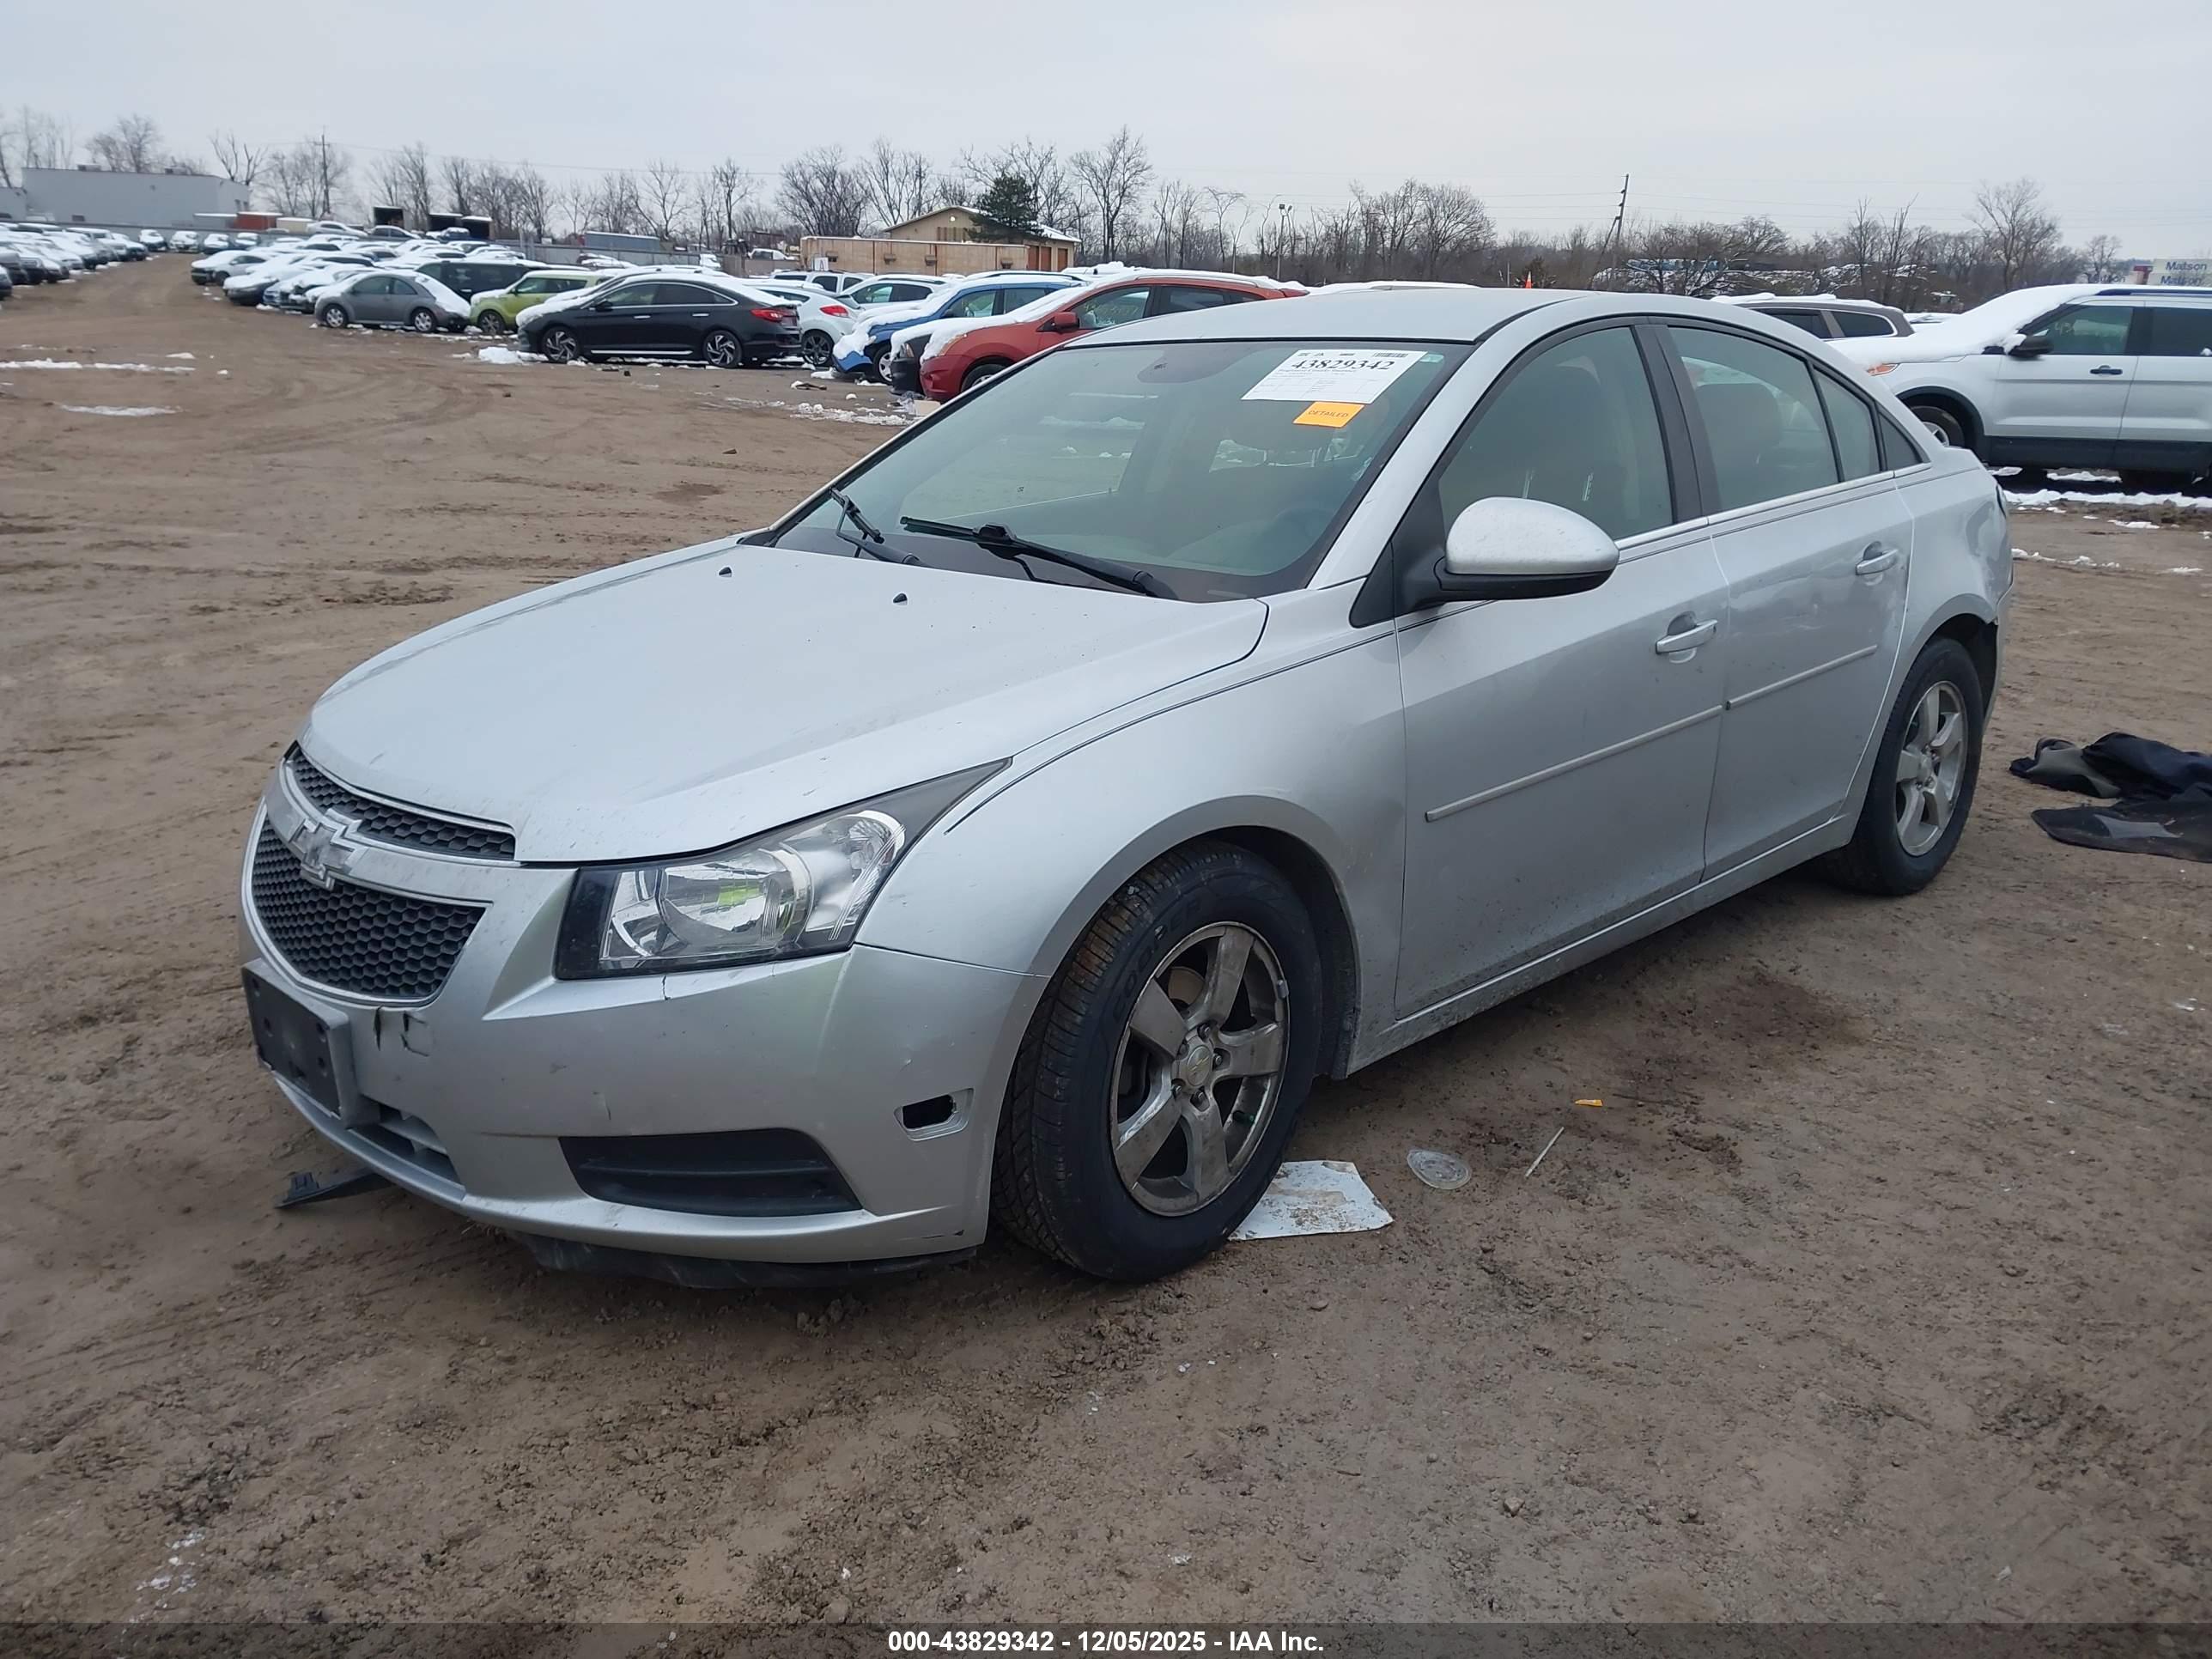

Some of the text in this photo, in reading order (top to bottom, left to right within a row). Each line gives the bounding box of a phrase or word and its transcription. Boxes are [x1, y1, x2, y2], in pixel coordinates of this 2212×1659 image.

[2165, 261, 2208, 270] Matson
[1291, 359, 1395, 370] 43829342
[1308, 410, 1349, 418] DETAILED
